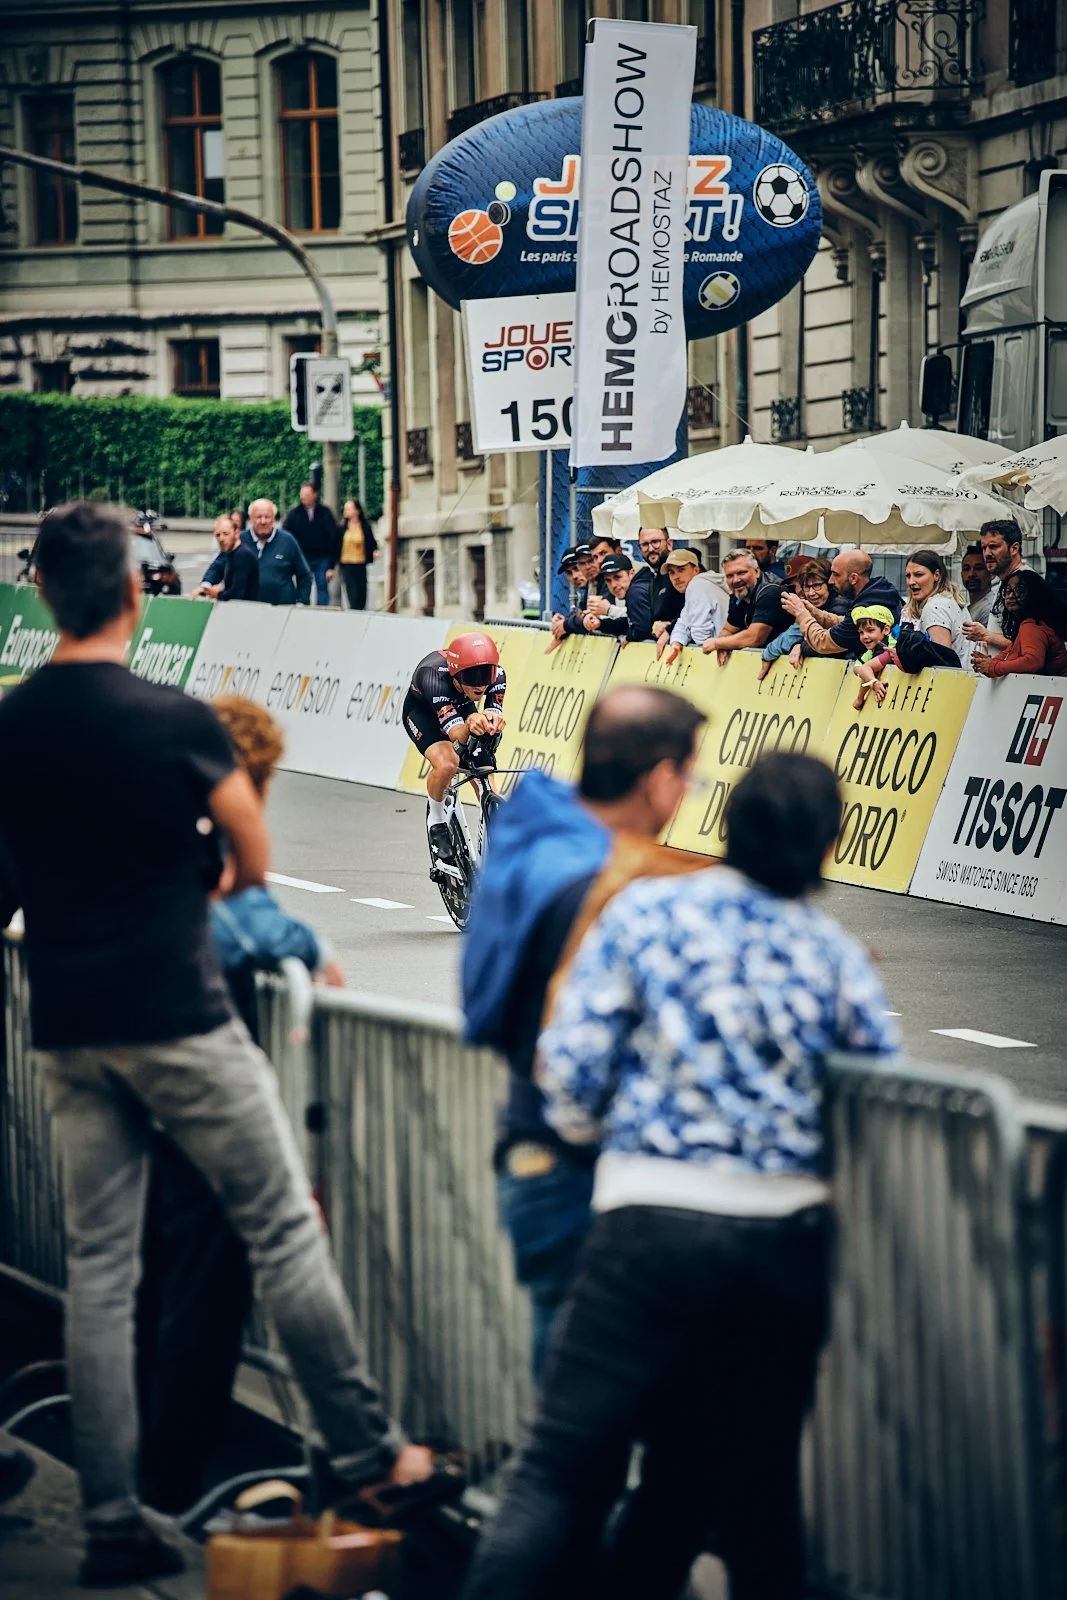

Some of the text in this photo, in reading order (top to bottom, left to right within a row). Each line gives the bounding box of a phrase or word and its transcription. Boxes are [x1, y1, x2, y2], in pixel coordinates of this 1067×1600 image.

[520, 250, 541, 262] Les
[541, 250, 572, 264] paris
[650, 170, 673, 334] by HEMOSTAZ
[691, 250, 744, 262] Romande
[481, 345, 575, 372] SPOR
[484, 321, 574, 348] JOUE
[1, 614, 62, 684] Europcar
[129, 627, 196, 686] Europcar
[518, 682, 586, 742] CHICCO
[833, 722, 937, 795] CHICCO
[953, 776, 1067, 859] TISSOT
[935, 860, 1039, 897] SWISS WATCHES SINCE 1853
